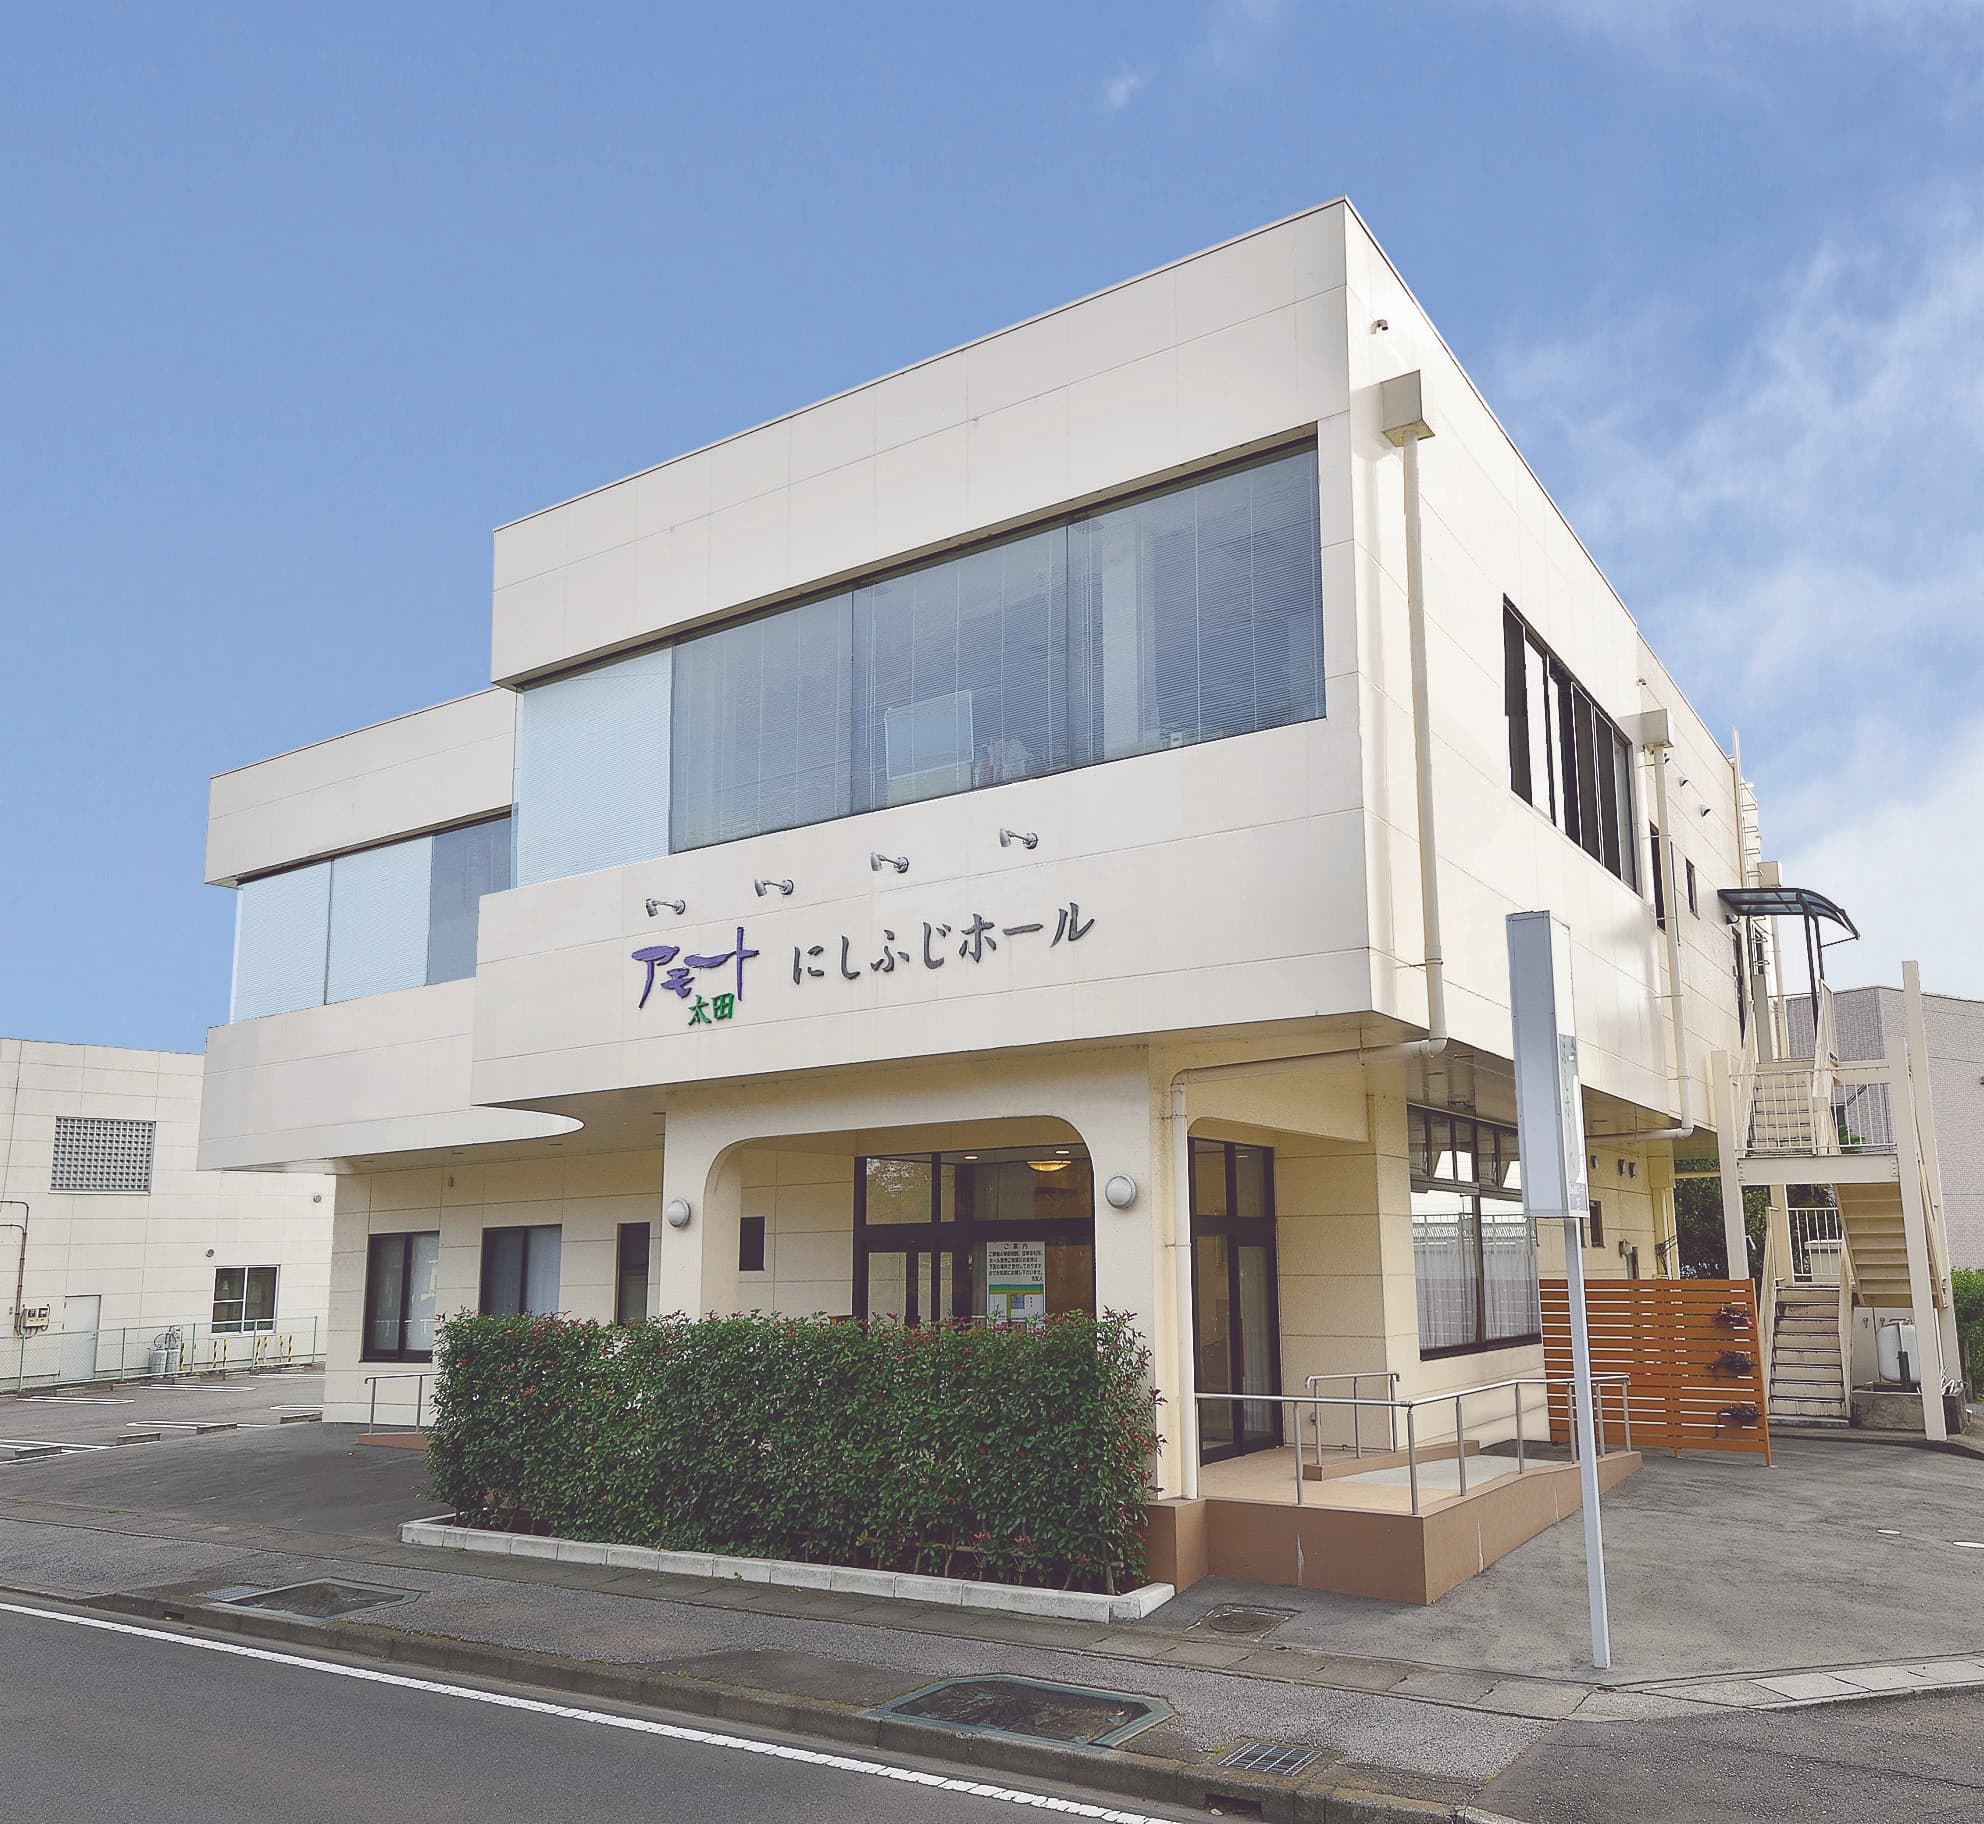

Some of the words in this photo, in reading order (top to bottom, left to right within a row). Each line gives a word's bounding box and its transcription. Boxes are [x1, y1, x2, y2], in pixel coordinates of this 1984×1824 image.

[792, 902, 1096, 985] にしふじホール
[687, 992, 735, 1026] 太田
